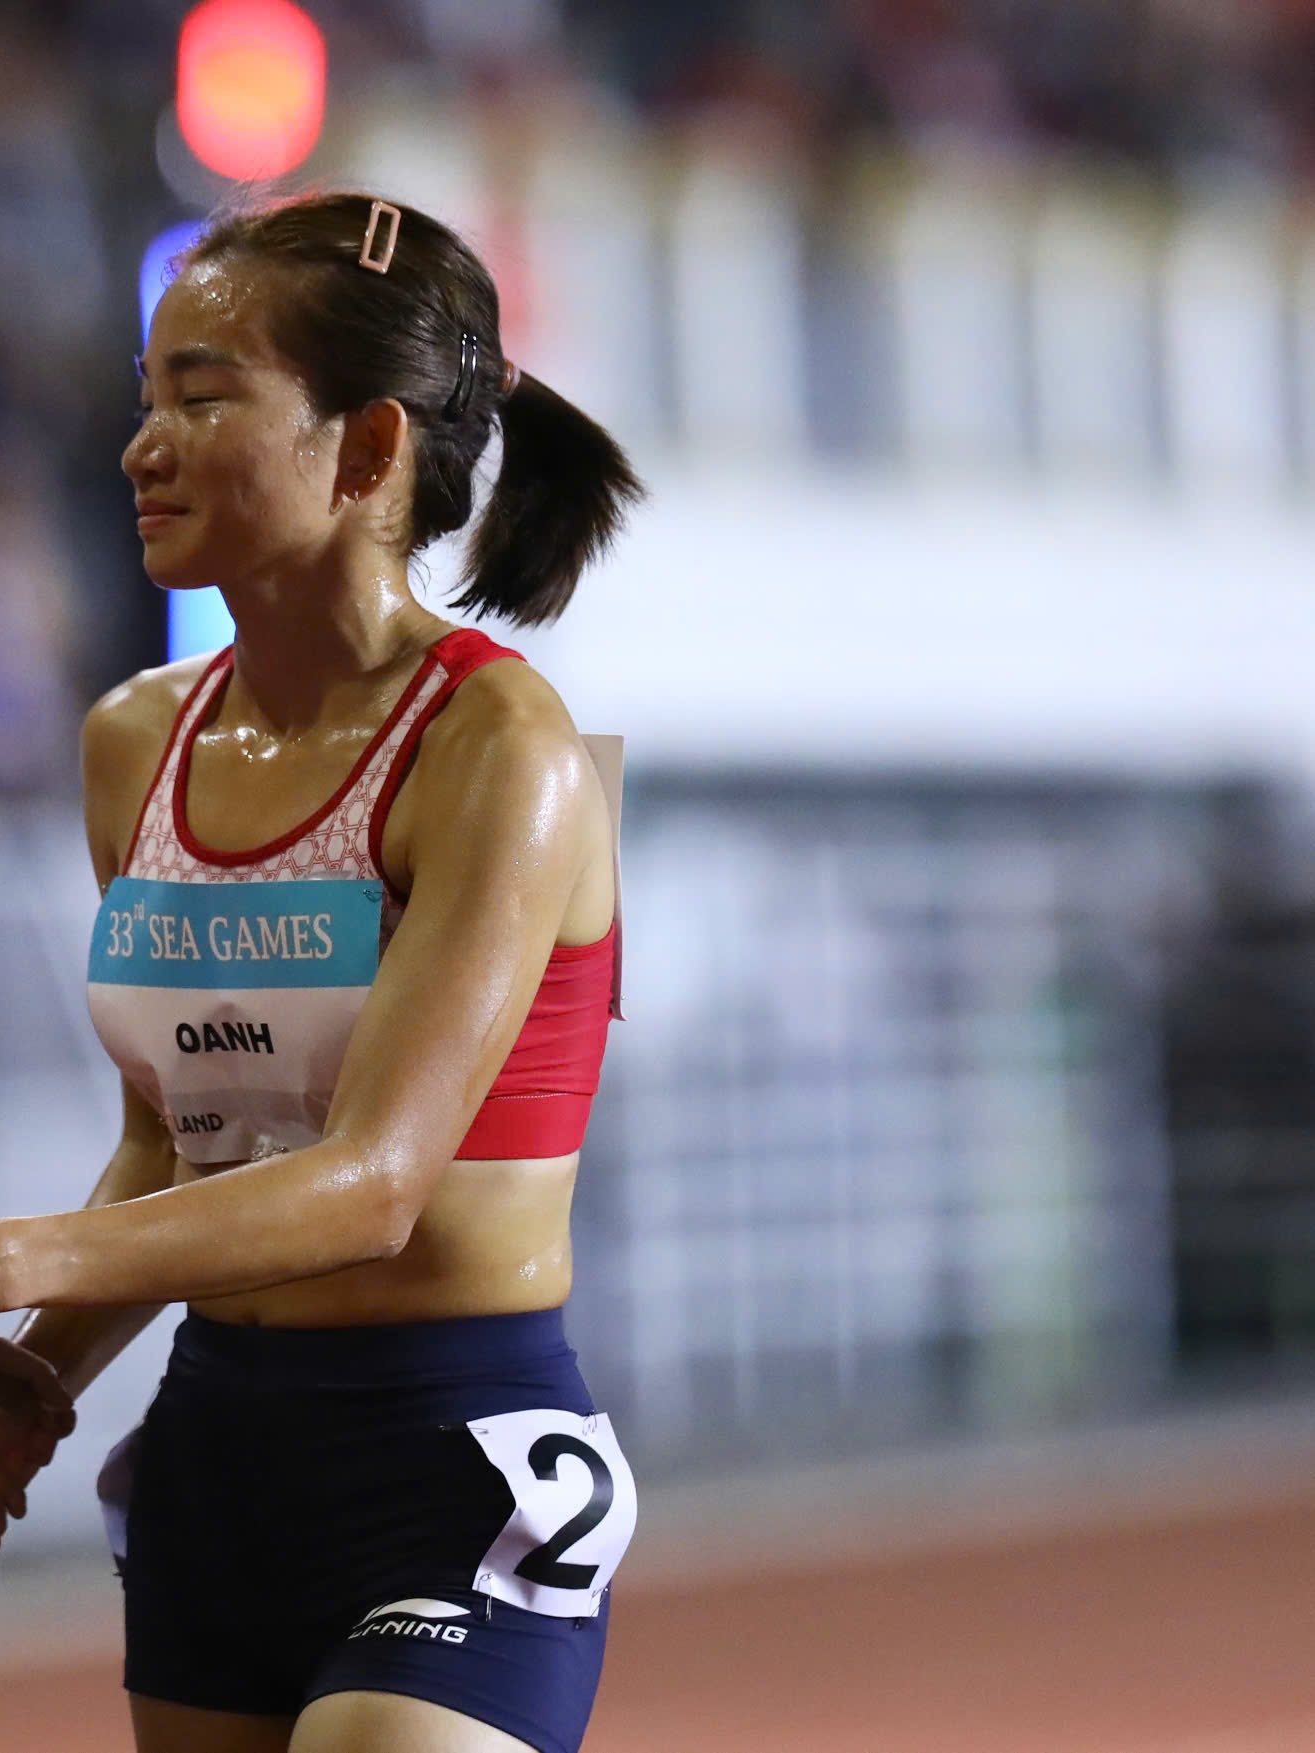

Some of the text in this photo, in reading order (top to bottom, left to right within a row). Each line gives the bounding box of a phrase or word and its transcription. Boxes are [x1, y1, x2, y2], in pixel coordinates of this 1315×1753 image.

[149, 913, 202, 960] SEA
[208, 913, 334, 961] GAMES
[175, 1021, 275, 1055] OANH
[513, 1432, 614, 1590] 2
